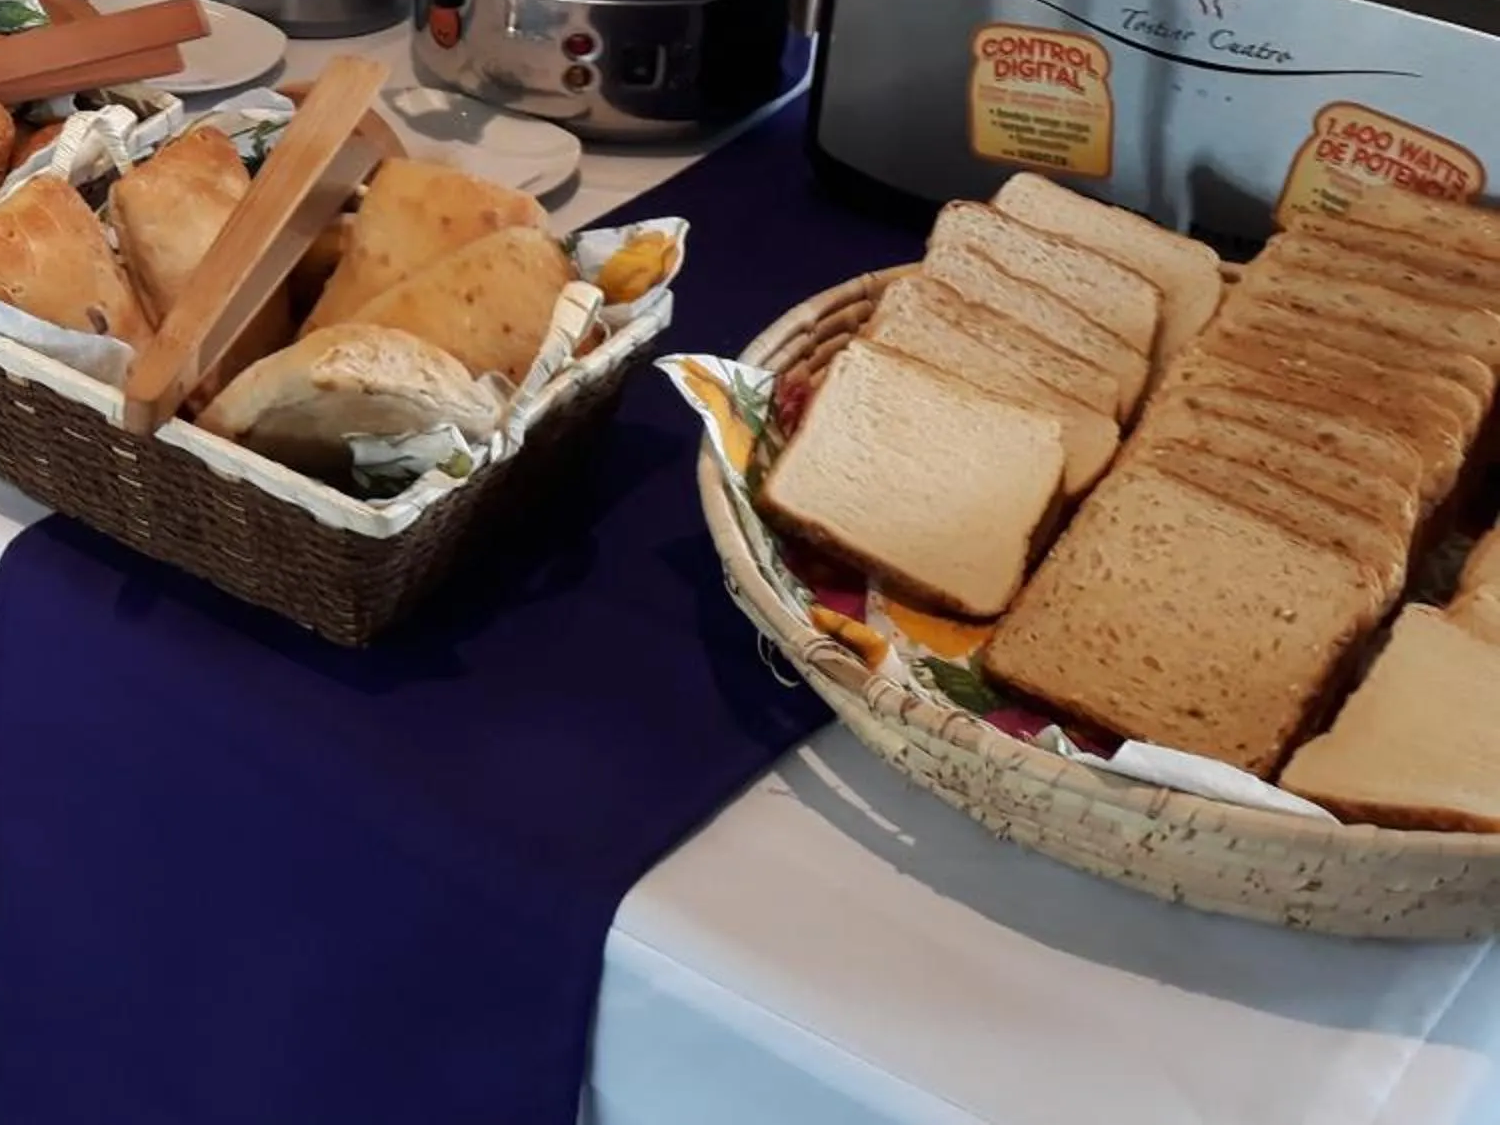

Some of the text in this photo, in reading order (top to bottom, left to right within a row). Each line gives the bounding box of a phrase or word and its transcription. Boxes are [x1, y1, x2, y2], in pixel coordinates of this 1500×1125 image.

[981, 36, 1100, 79] CONTROL
[994, 58, 1086, 95] DIGITAL
[1315, 139, 1349, 164] DE
[1399, 138, 1470, 194] WATTS
